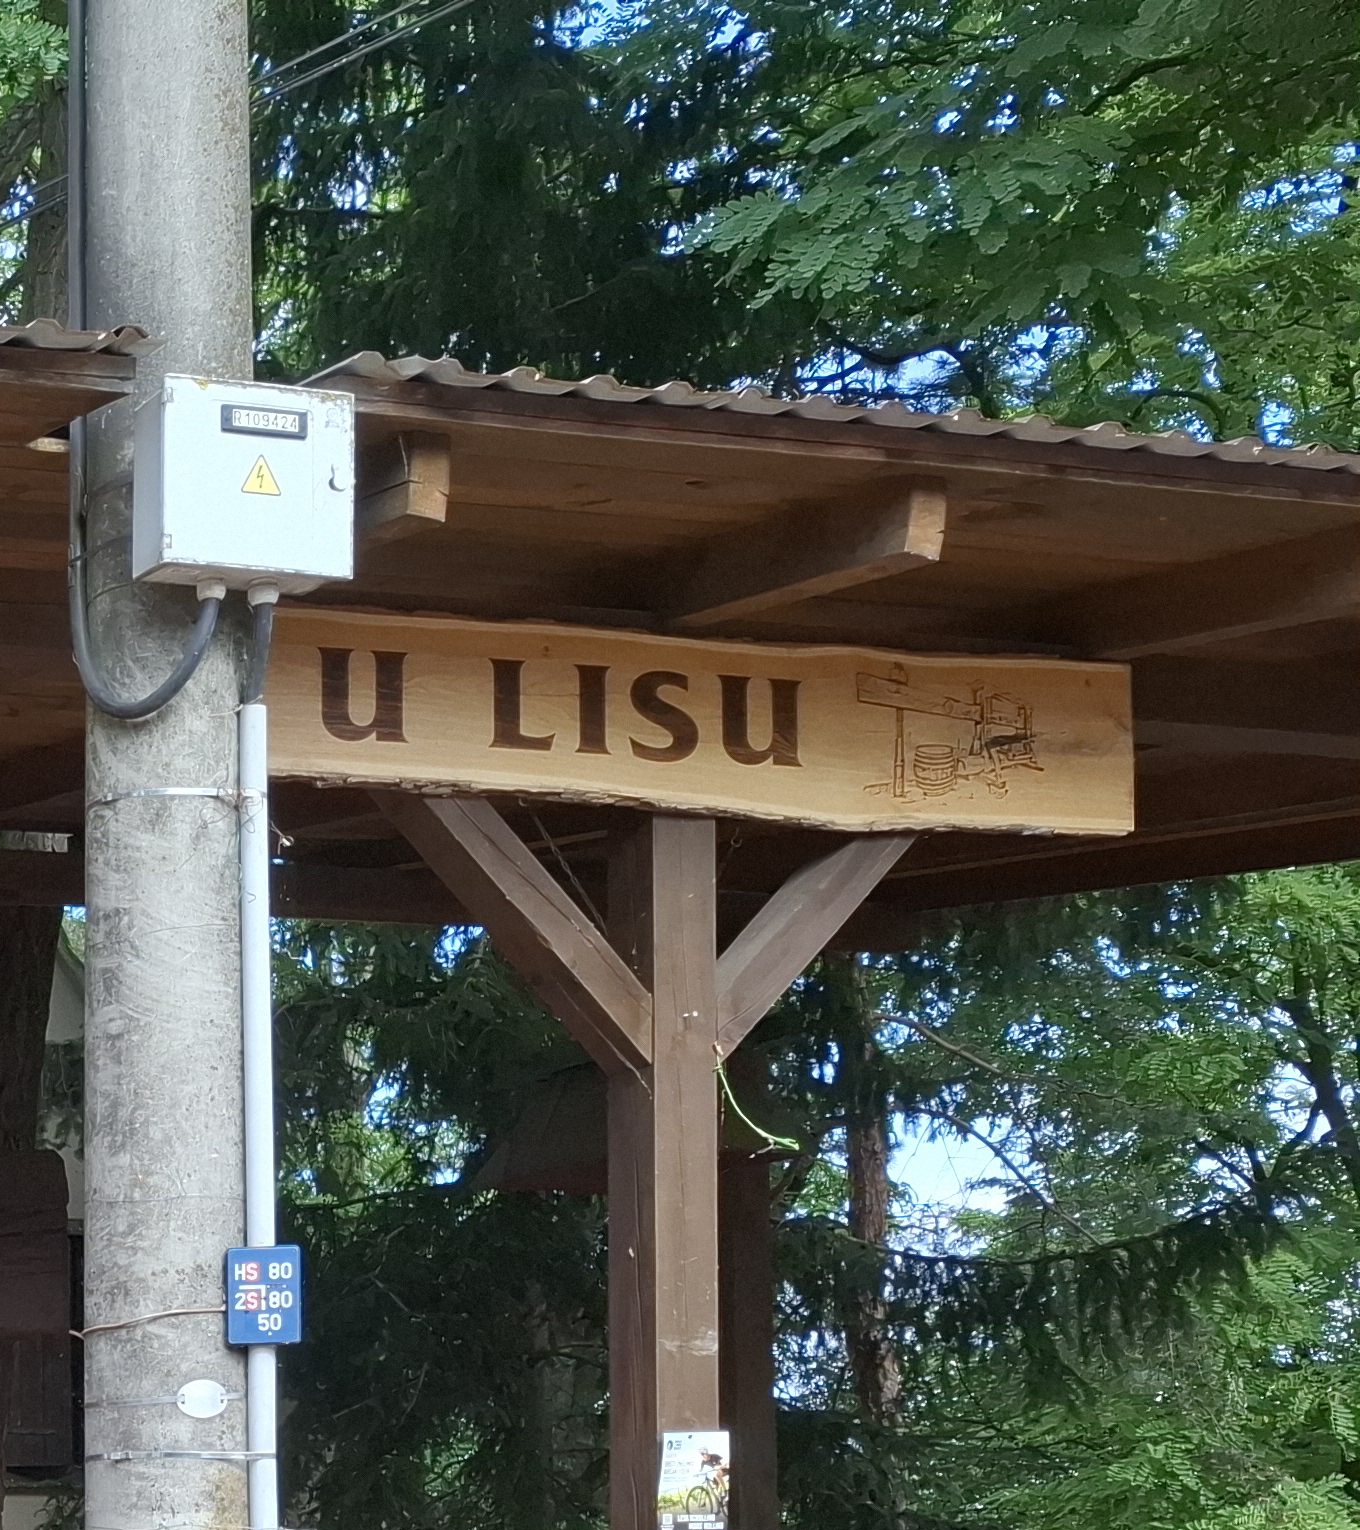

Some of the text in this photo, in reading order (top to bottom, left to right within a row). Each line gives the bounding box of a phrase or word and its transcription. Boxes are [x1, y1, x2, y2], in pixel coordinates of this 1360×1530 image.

[233, 410, 297, 430] R109424
[316, 645, 804, 768] U LISU
[234, 1261, 293, 1281] HS 80
[268, 1291, 293, 1309] 80
[257, 1313, 282, 1331] 50
